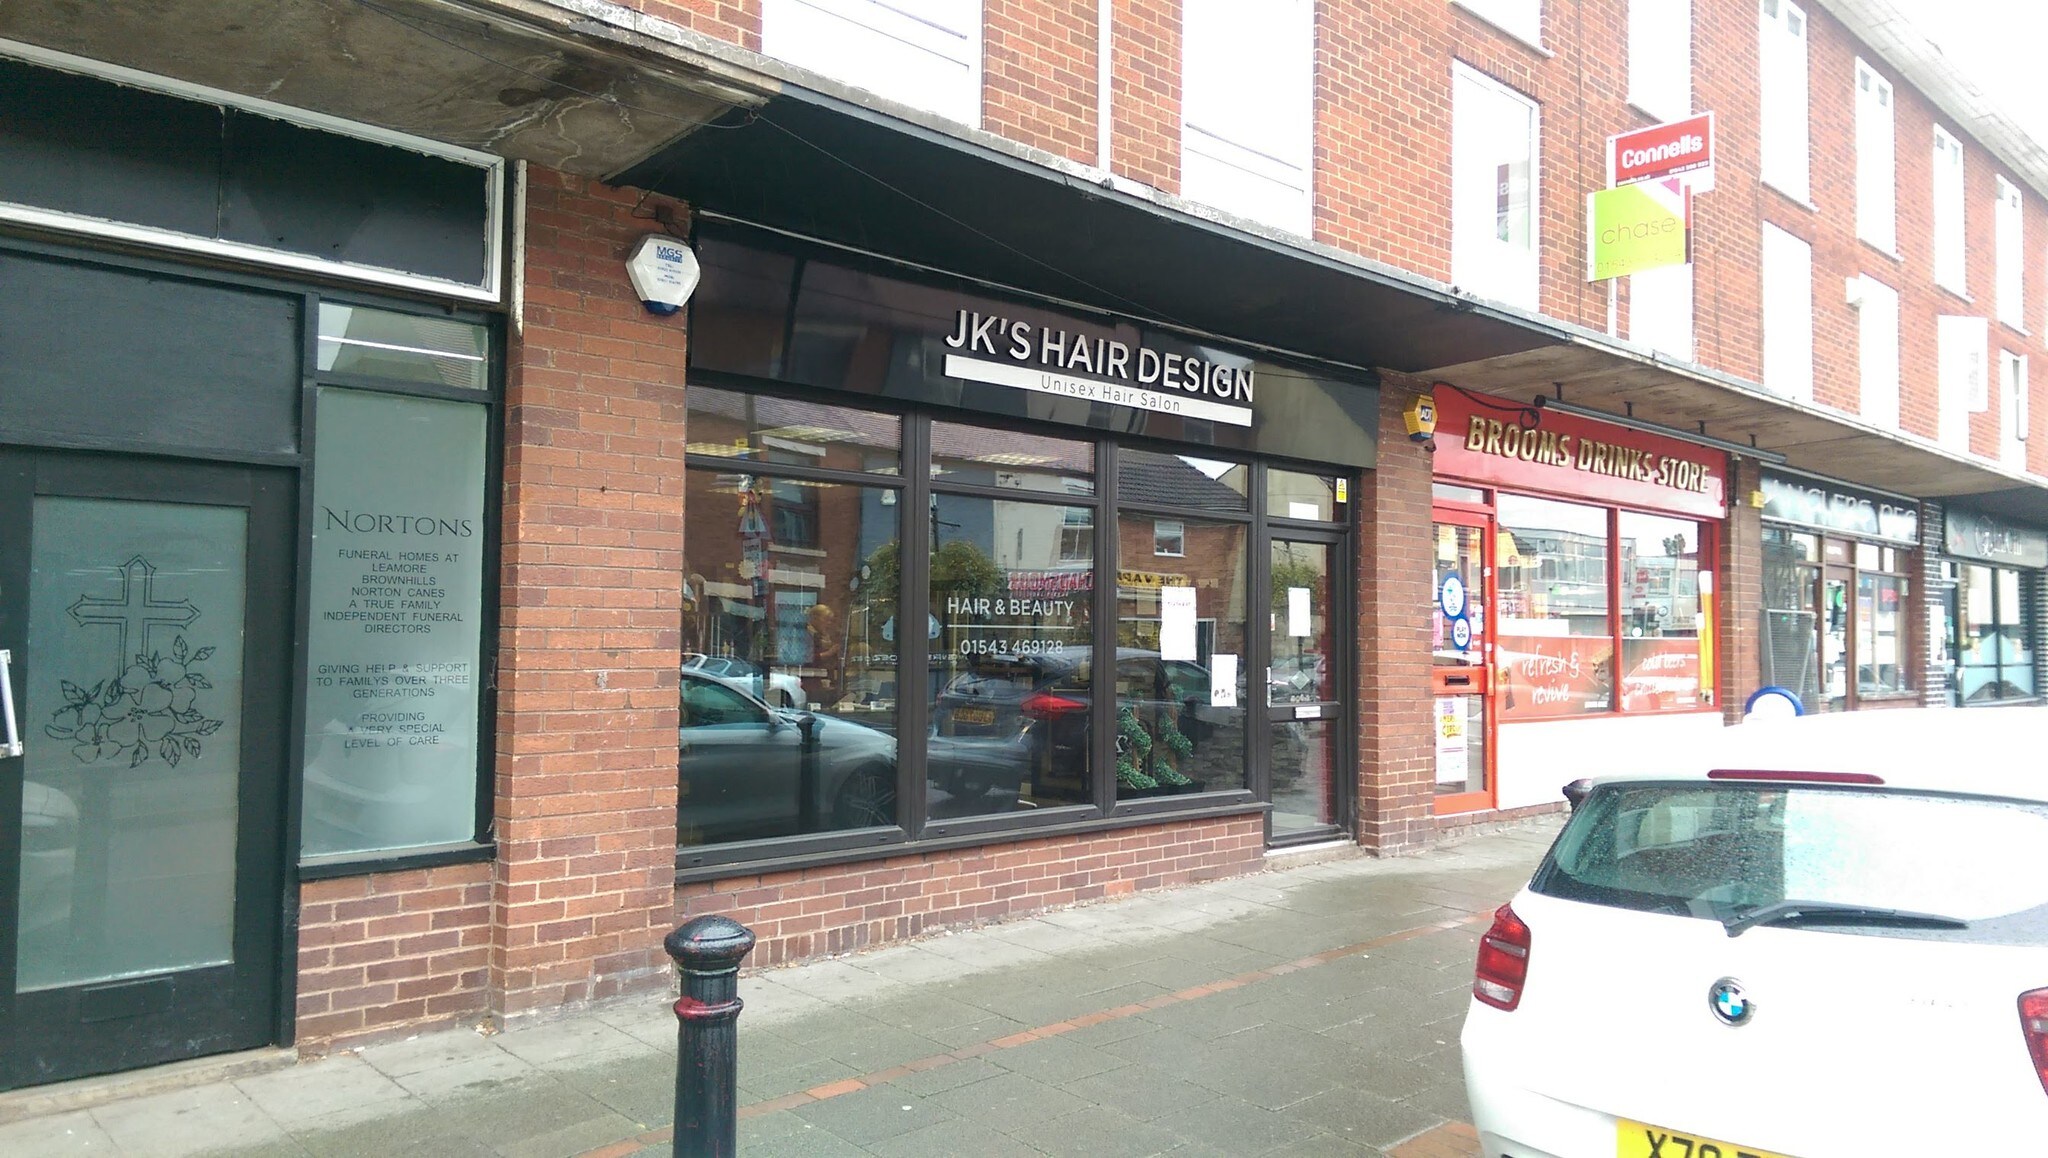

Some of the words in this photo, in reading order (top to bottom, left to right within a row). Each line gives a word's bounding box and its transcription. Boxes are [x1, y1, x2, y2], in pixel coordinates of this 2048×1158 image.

[1622, 134, 1703, 169] Connells
[1601, 217, 1676, 245] chase
[657, 246, 683, 258] MGS
[945, 310, 1031, 361] JK'S
[1041, 327, 1129, 380] HAIR
[1138, 348, 1255, 403] DESIGN
[1041, 375, 1096, 399] Unisex
[1103, 385, 1133, 404] Hair
[1141, 392, 1181, 412] Salon
[1465, 415, 1570, 467] BROOMS
[1575, 438, 1653, 483] DRINKS
[1655, 455, 1711, 494] STORE
[338, 549, 392, 560] FUNERAL
[399, 552, 439, 561] HOMES
[445, 553, 459, 562] AT
[372, 563, 427, 573] LEAMORE
[362, 575, 436, 585] BROWNHILLS
[352, 587, 401, 597] NORTON
[407, 588, 445, 598] CANES
[349, 600, 357, 608] A
[363, 600, 394, 609] TRUE
[401, 600, 441, 610] FAMILY
[947, 597, 990, 615] HAIR
[995, 599, 1006, 616] &
[1011, 600, 1074, 617] BEAUTY
[324, 611, 406, 621] INDEPENDENT
[413, 612, 463, 622] FUNERAL
[364, 624, 431, 634] DIRECTORS
[960, 639, 1007, 655] 01543
[1012, 639, 1064, 655] 469128
[1522, 644, 1567, 677] refresh
[1569, 651, 1581, 678] &
[318, 664, 359, 674] GIVING
[366, 664, 396, 673] HELP
[402, 664, 409, 673] &
[415, 663, 468, 673] SUPPORT
[316, 676, 333, 686] TO
[339, 676, 389, 686] FAMILYS
[395, 676, 426, 685] OVER
[433, 675, 469, 685] THREE
[353, 688, 435, 698] GENERATIONS
[1532, 678, 1570, 705] revive
[362, 712, 425, 722] PROVIDING
[360, 725, 393, 734] VERY
[400, 723, 445, 733] SPECIAL
[344, 739, 381, 749] LEVEL
[387, 737, 402, 747] OF
[409, 735, 439, 745] CARE
